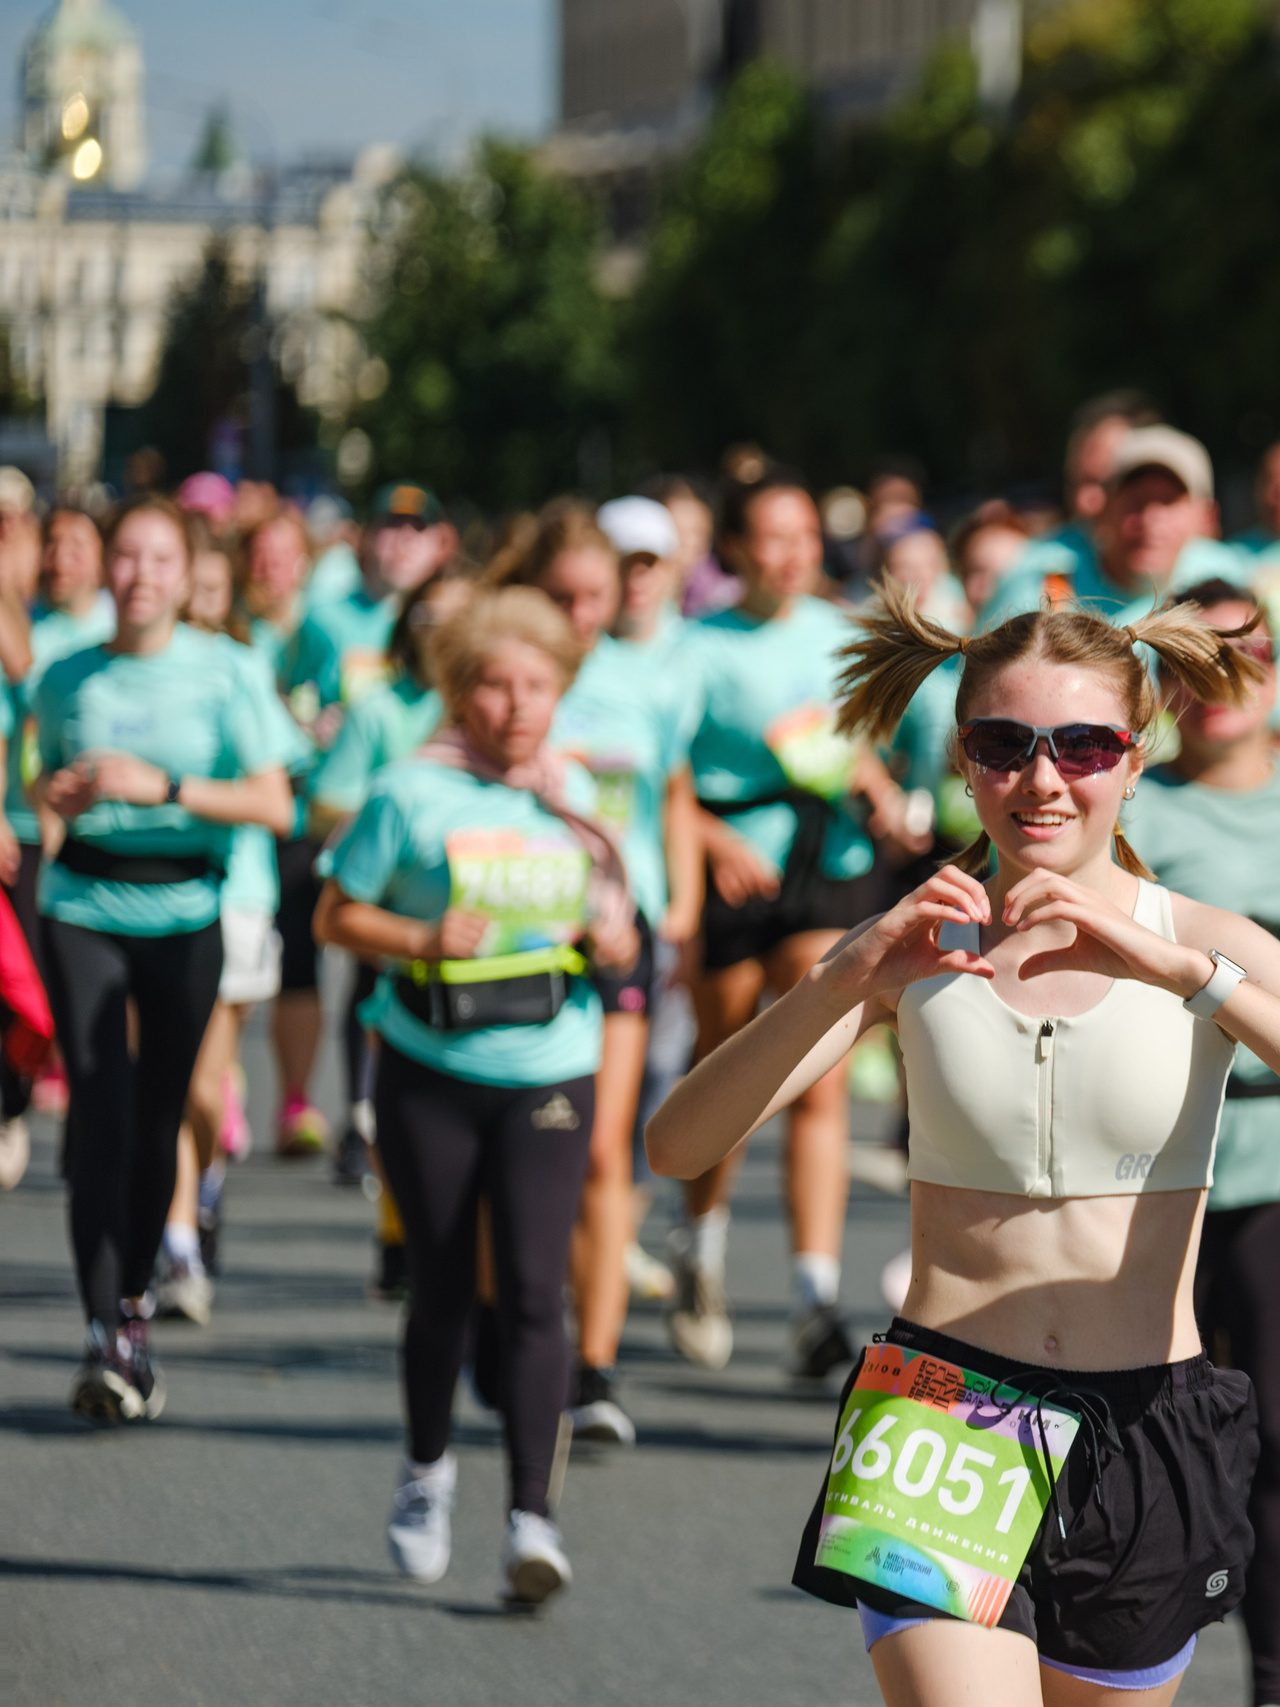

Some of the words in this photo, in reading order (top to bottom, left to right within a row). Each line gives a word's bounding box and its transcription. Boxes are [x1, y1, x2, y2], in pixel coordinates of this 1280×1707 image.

[914, 1373, 984, 1409] ФЕСТИВАЛЬ
[919, 1360, 991, 1396] БОЛЬШОЙ
[831, 1408, 1032, 1534] 66051
[905, 1516, 1009, 1565] ДВИЖЕНИЯ
[882, 1560, 905, 1576] СПОРТ
[886, 1551, 933, 1576] МОСКОВСКИЙ
